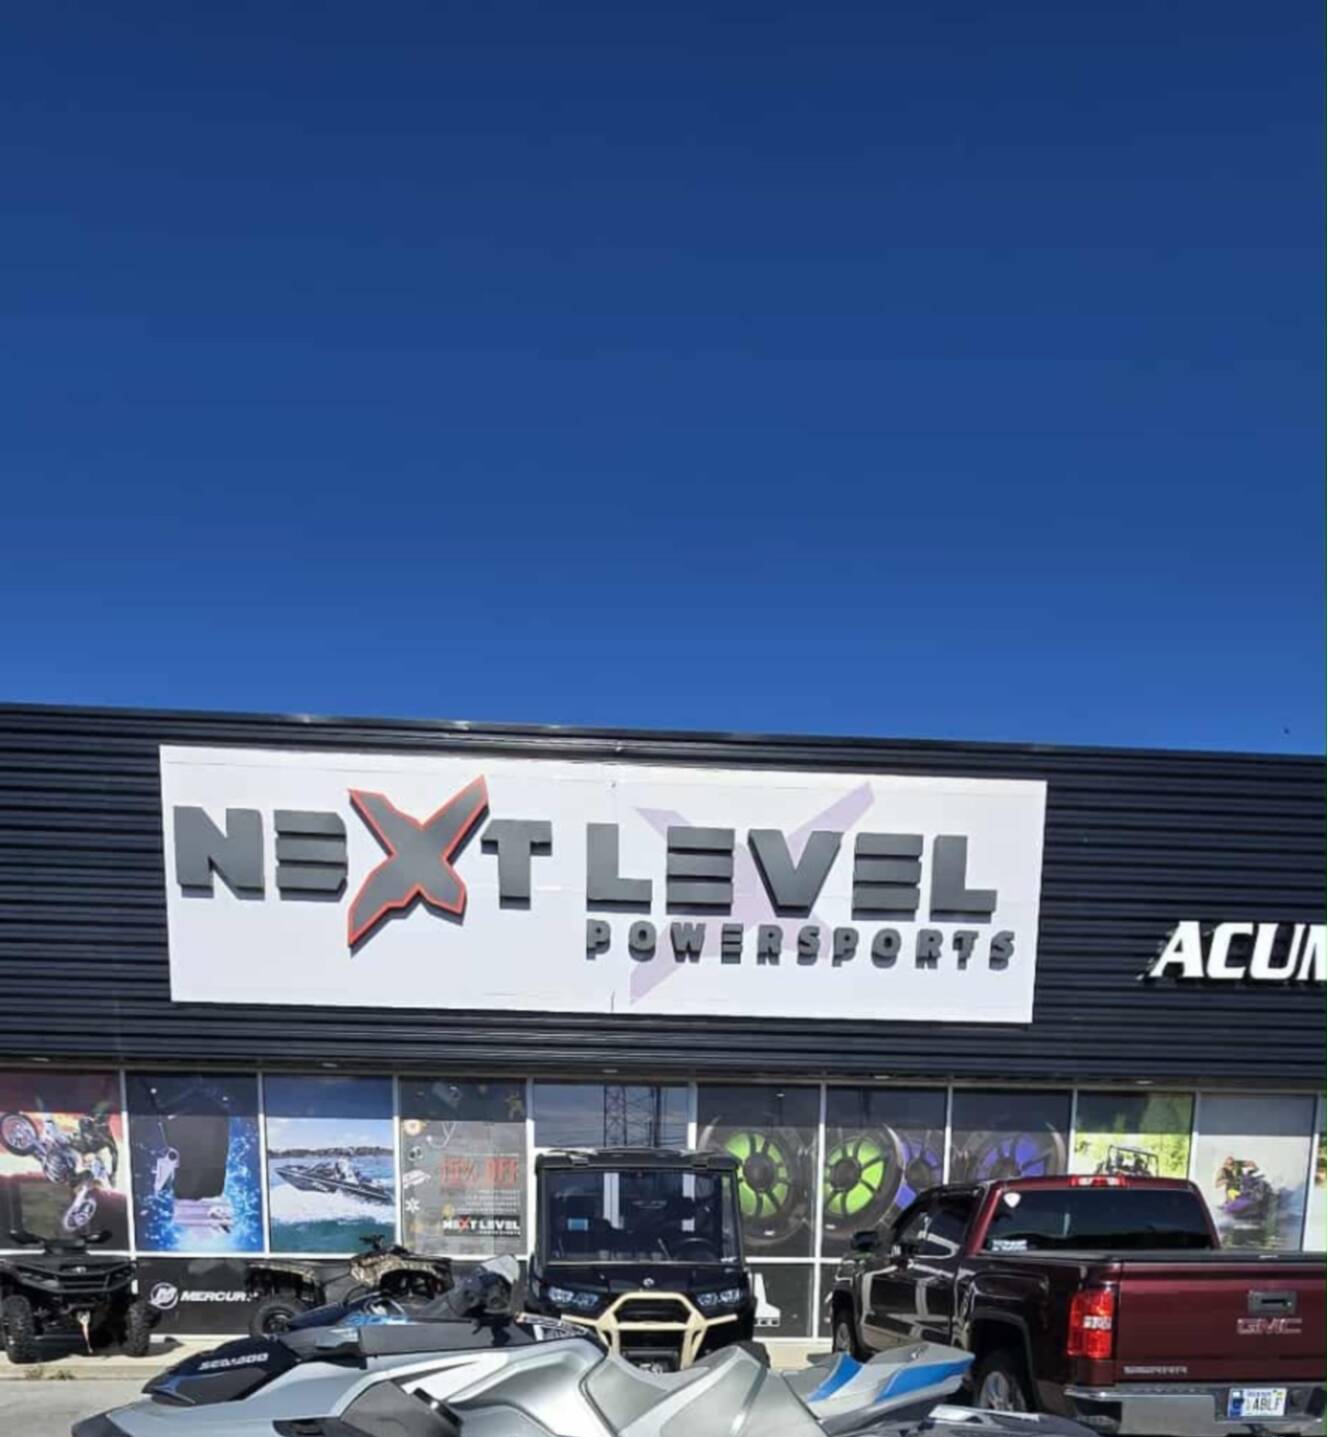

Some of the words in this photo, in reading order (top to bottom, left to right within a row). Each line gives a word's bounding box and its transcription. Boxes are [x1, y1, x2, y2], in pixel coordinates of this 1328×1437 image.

[173, 775, 552, 953] NEXT
[586, 823, 998, 923] LEVEL
[586, 919, 1016, 971] POWERSPORTS
[479, 1219, 520, 1230] LEVEL
[180, 1291, 259, 1302] MERCUR
